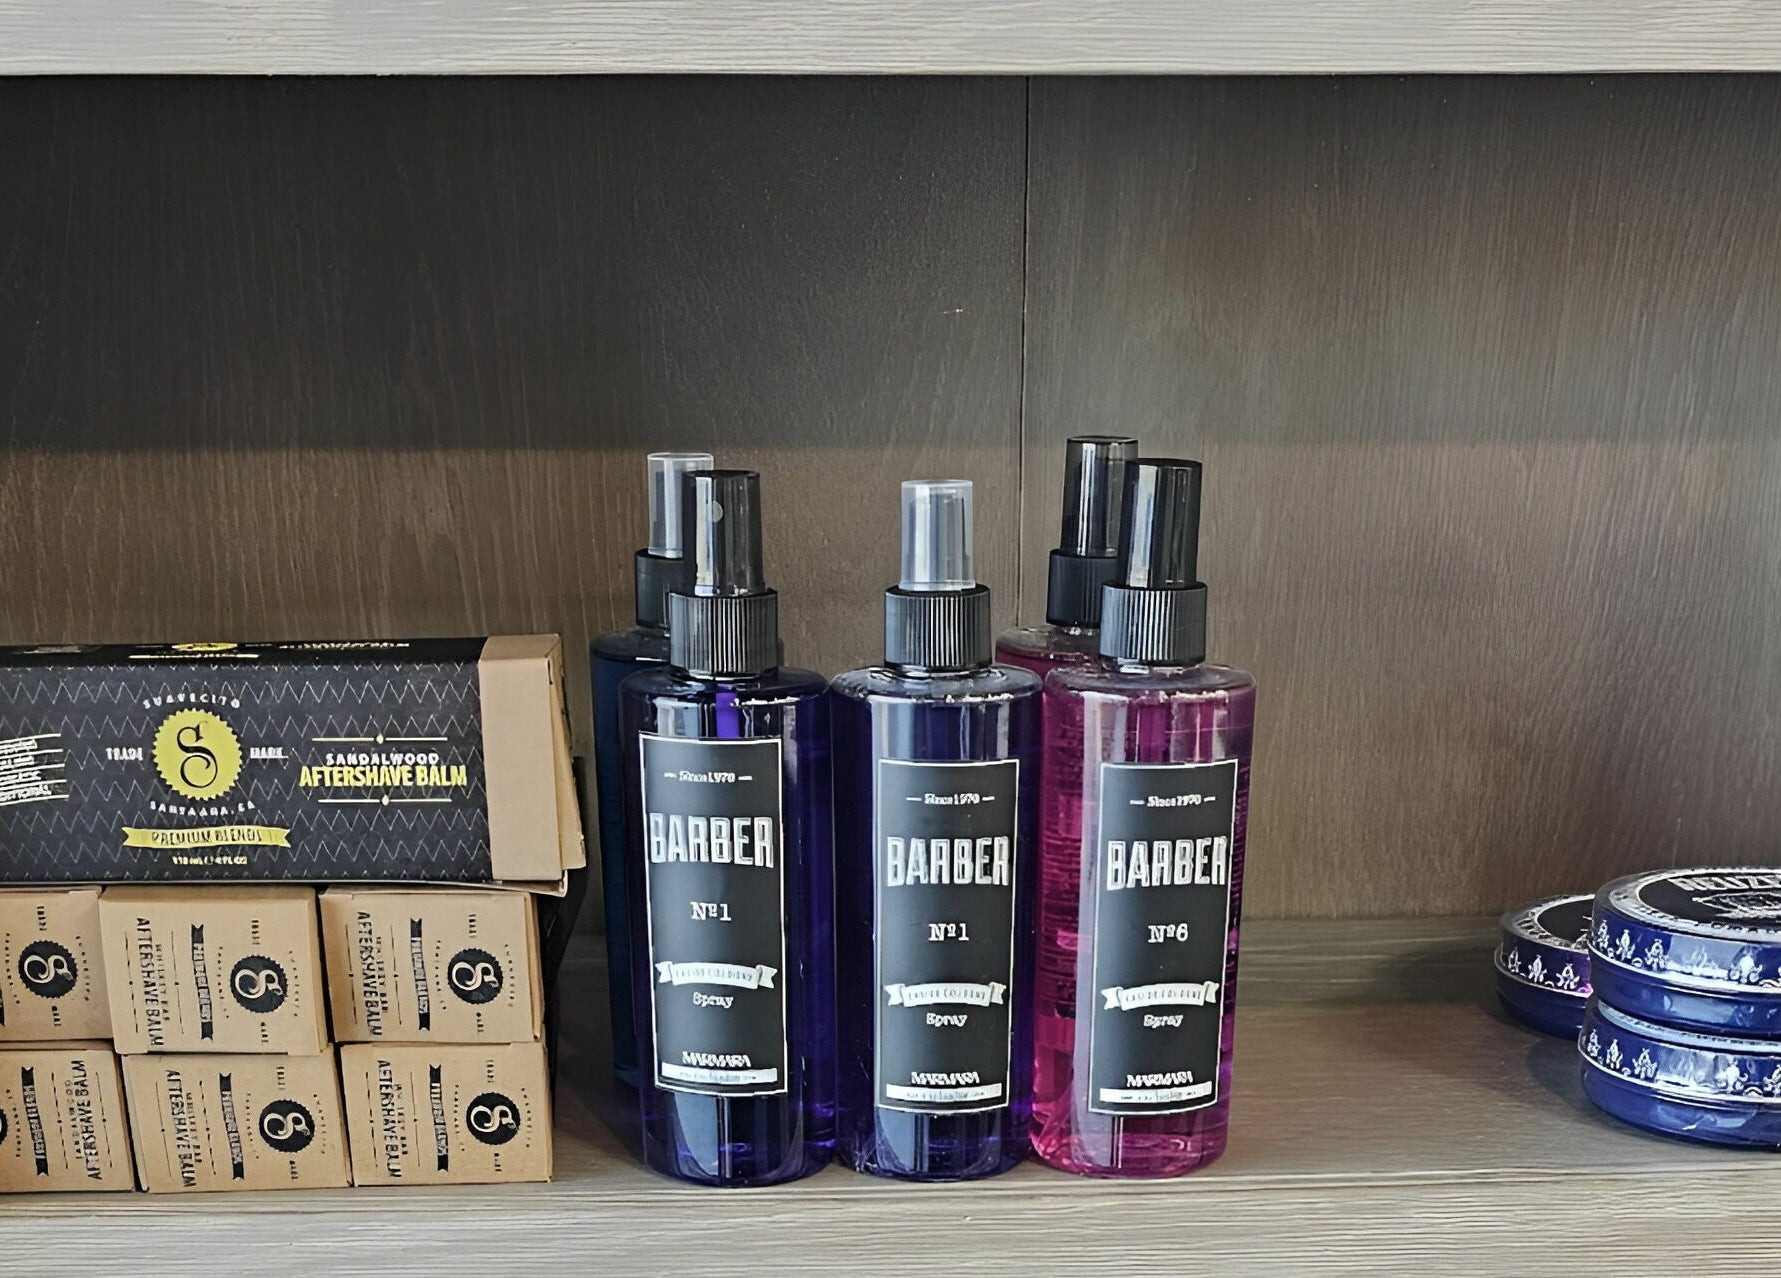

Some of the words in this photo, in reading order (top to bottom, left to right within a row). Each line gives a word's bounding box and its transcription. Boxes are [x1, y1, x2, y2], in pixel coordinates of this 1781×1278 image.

[143, 693, 241, 709] SUAVECITO
[299, 765, 414, 787] AFTERSHAVE
[415, 764, 468, 787] BALM
[325, 752, 440, 766] SANDALWOOD
[649, 812, 774, 868] BARBER
[887, 836, 1009, 887] BARBER
[1106, 836, 1227, 891] BARBER
[1667, 875, 1781, 891] REUZE
[136, 918, 158, 1005] AFTERSHAVE
[357, 911, 378, 997] AFTERSHAVE
[693, 991, 734, 1009] Spray
[926, 1012, 968, 1027] Spray
[1143, 1014, 1184, 1028] Spray
[71, 1060, 90, 1097] BALM
[166, 1069, 191, 1150] AFTERSHAVE
[377, 1060, 398, 1140] AFTERSHAVE
